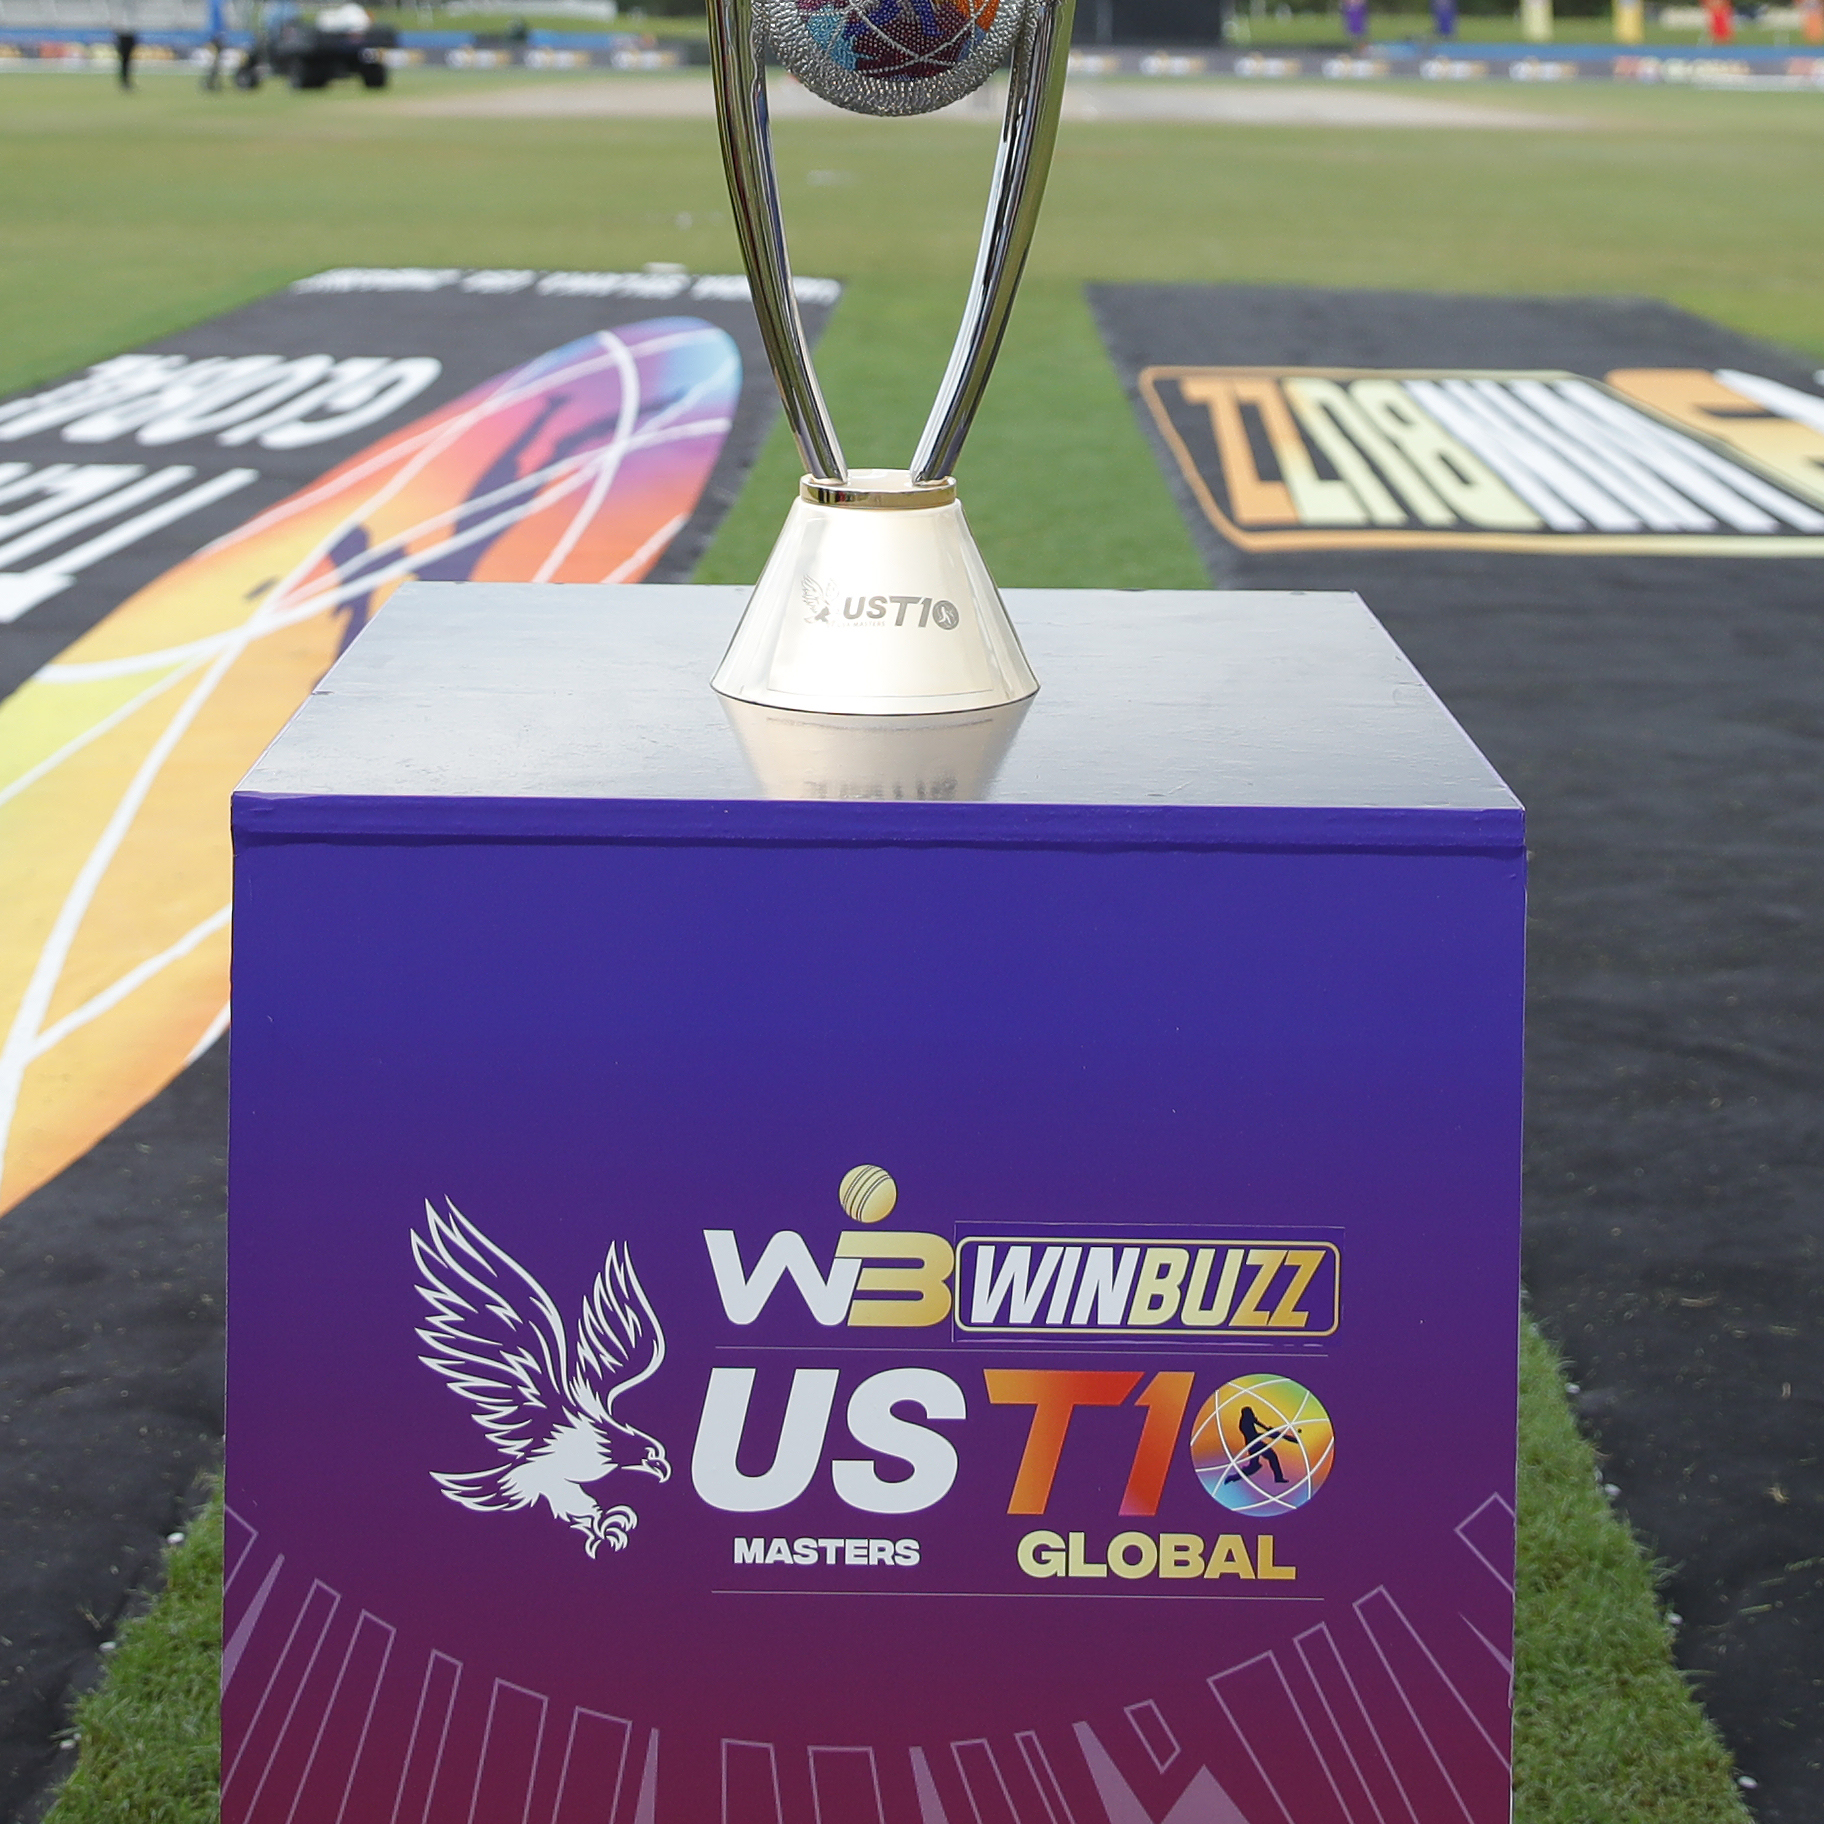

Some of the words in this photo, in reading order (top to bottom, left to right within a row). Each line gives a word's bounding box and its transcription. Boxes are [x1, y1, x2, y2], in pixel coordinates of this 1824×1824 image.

[970, 1245, 1326, 1328] WINBUZZ
[732, 1537, 921, 1567] MASTERS
[1016, 1529, 1297, 1581] GLOBAL
